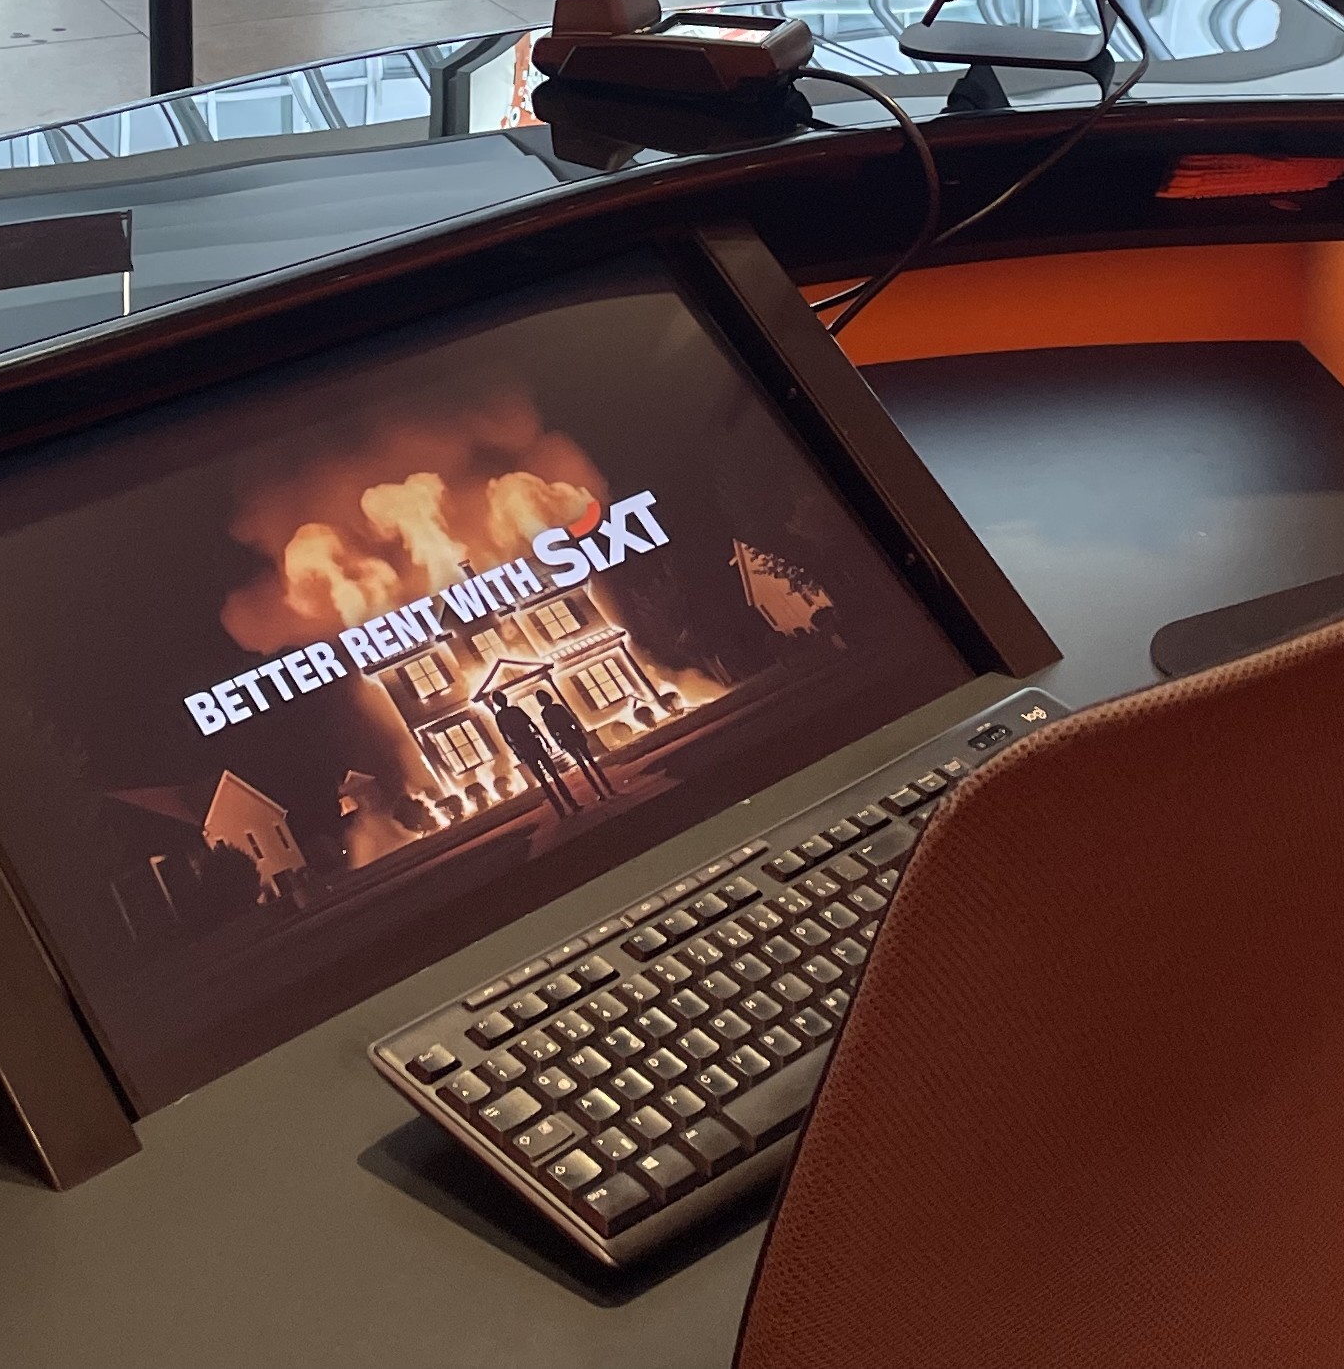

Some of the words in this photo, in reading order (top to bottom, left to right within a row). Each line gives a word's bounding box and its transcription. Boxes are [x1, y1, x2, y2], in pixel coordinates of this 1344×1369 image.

[184, 640, 348, 736] BETTER
[339, 596, 444, 670] RENT
[439, 557, 544, 624] WITH
